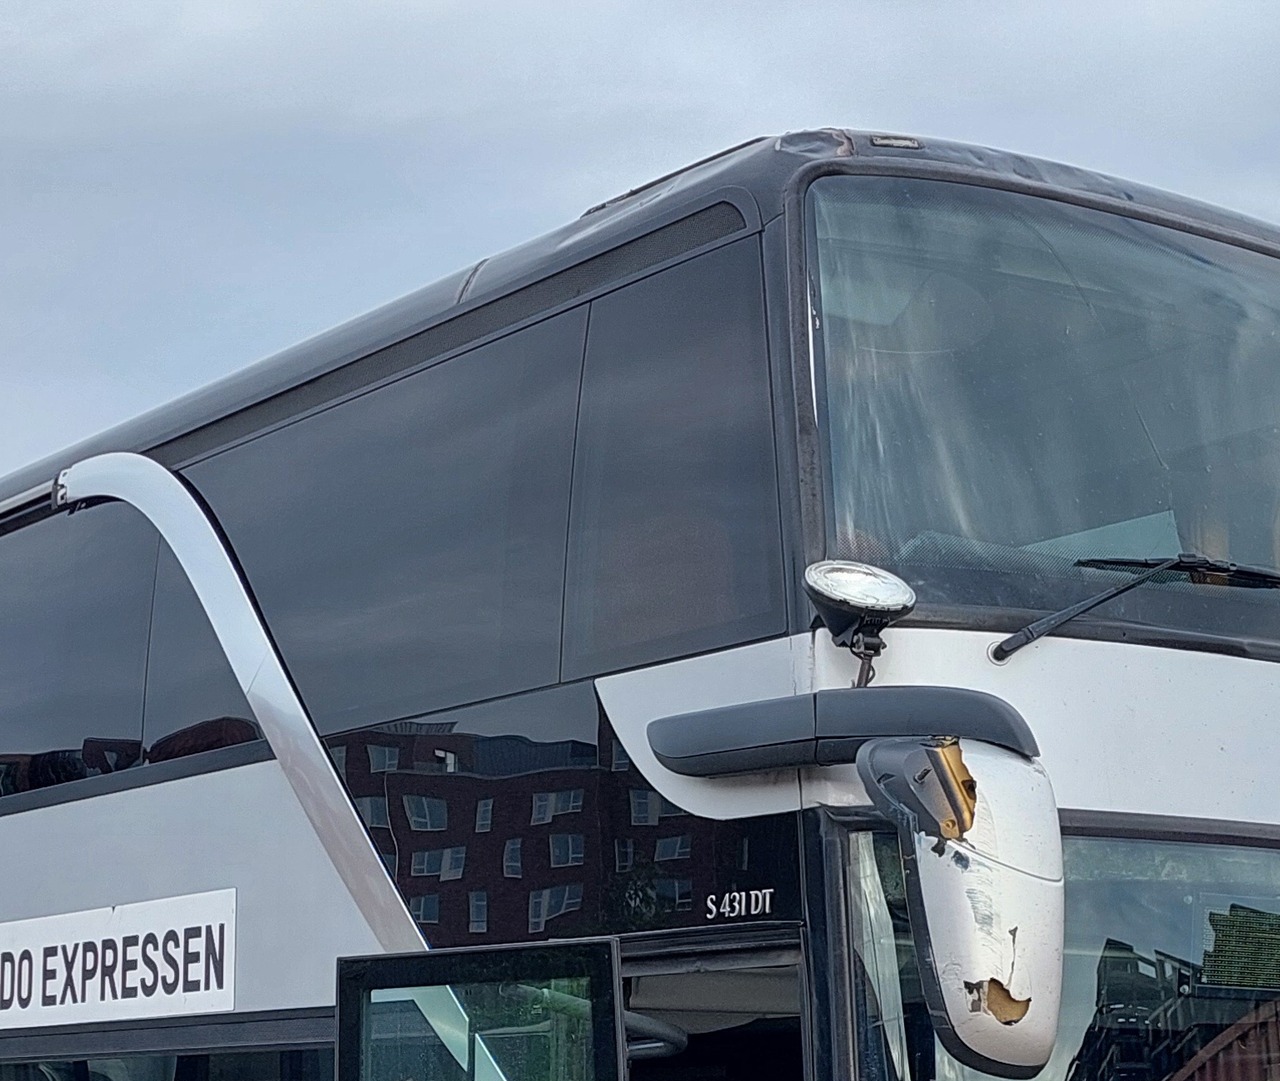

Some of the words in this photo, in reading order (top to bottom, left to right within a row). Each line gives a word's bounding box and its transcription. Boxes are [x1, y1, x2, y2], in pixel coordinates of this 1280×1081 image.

[706, 894, 717, 919] S
[719, 892, 746, 917] 431
[749, 888, 774, 915] DT
[41, 923, 226, 1007] EXPRESSEN
